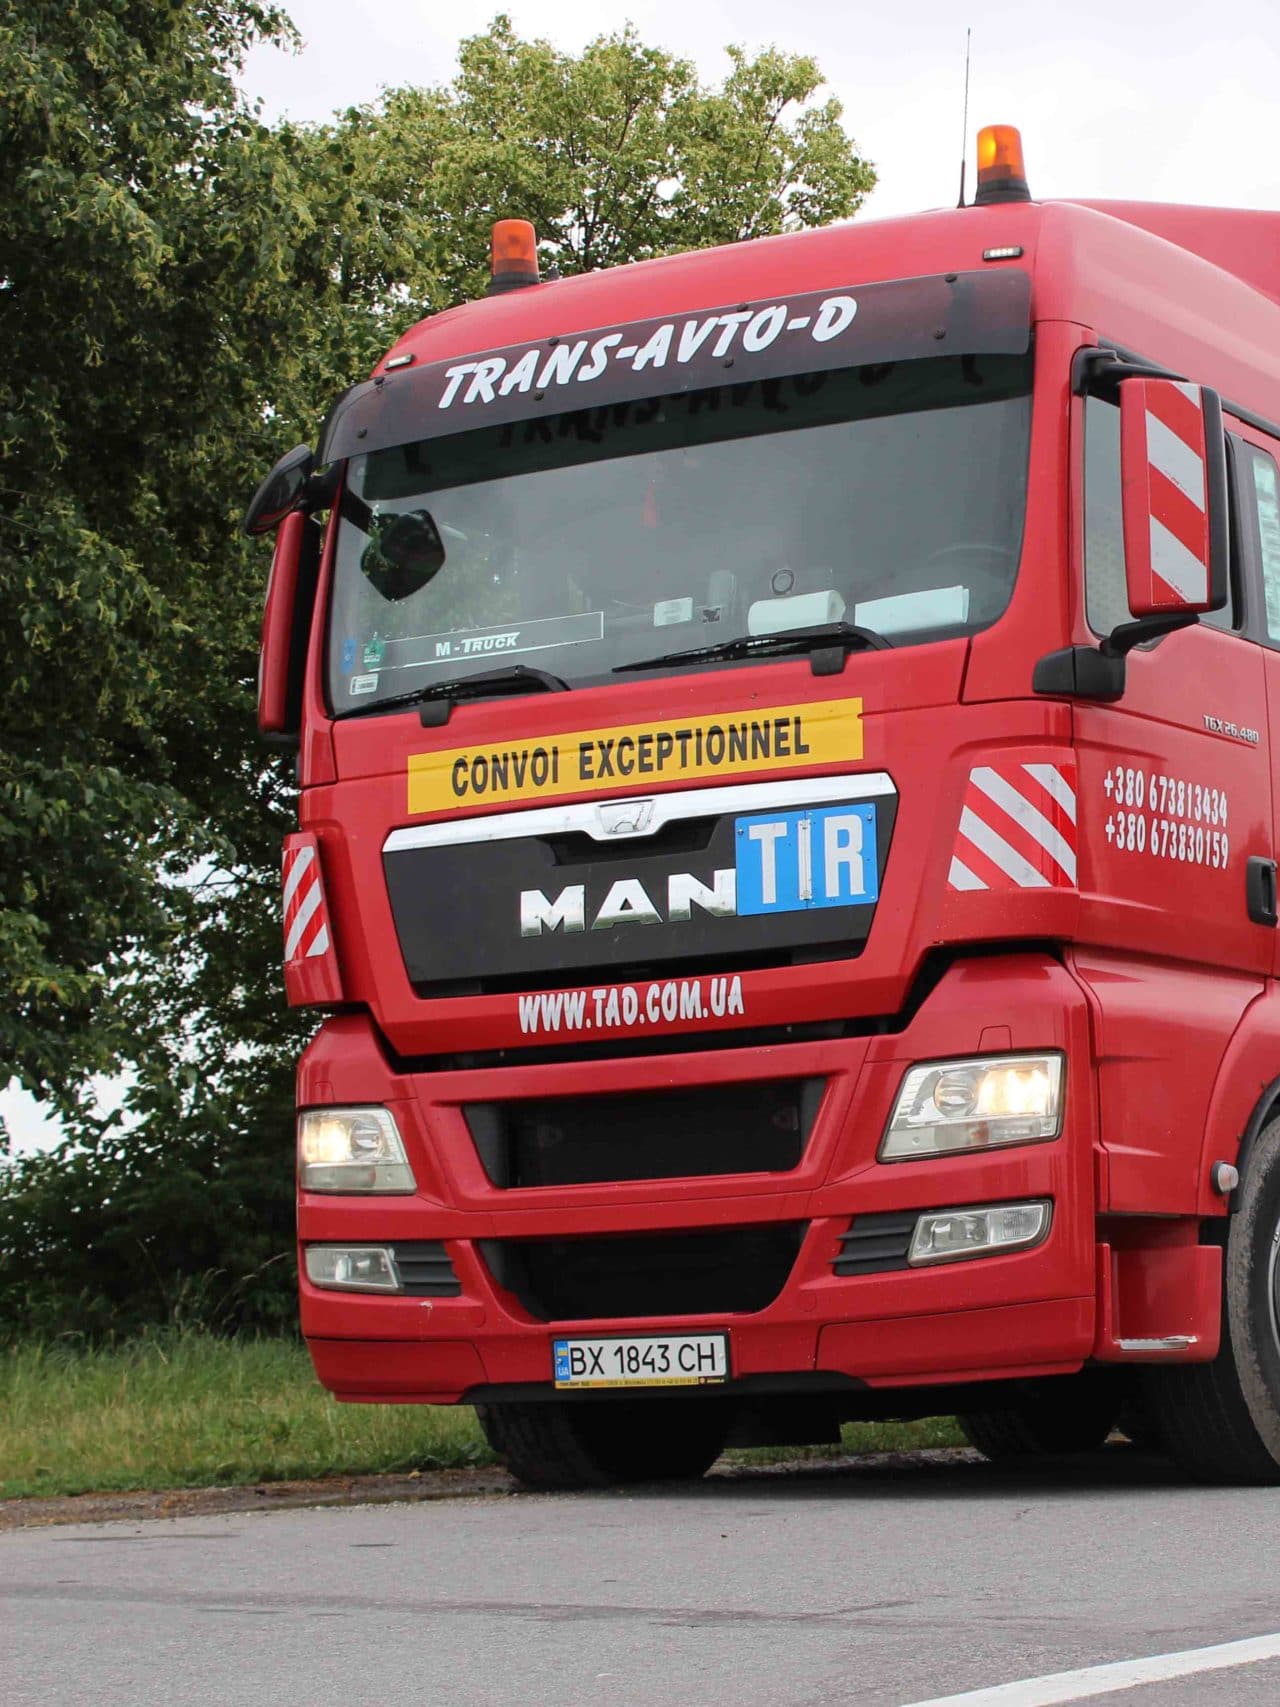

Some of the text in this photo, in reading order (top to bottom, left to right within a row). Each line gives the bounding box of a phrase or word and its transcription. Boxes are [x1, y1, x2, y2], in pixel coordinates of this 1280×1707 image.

[438, 296, 857, 409] TRANS-AVTO-D
[452, 716, 810, 796] CONVOI EXCEPTIONNEL
[1224, 721, 1259, 744] 26.480
[1104, 766, 1227, 827] +380 673813434
[749, 814, 866, 904] TIR
[1105, 811, 1229, 870] +380 673830159
[520, 868, 736, 937] MAN
[519, 976, 744, 1034] WWW.TAD.COM.UA
[557, 1367, 570, 1376] UA
[570, 1342, 716, 1376] BX 1843 CH
